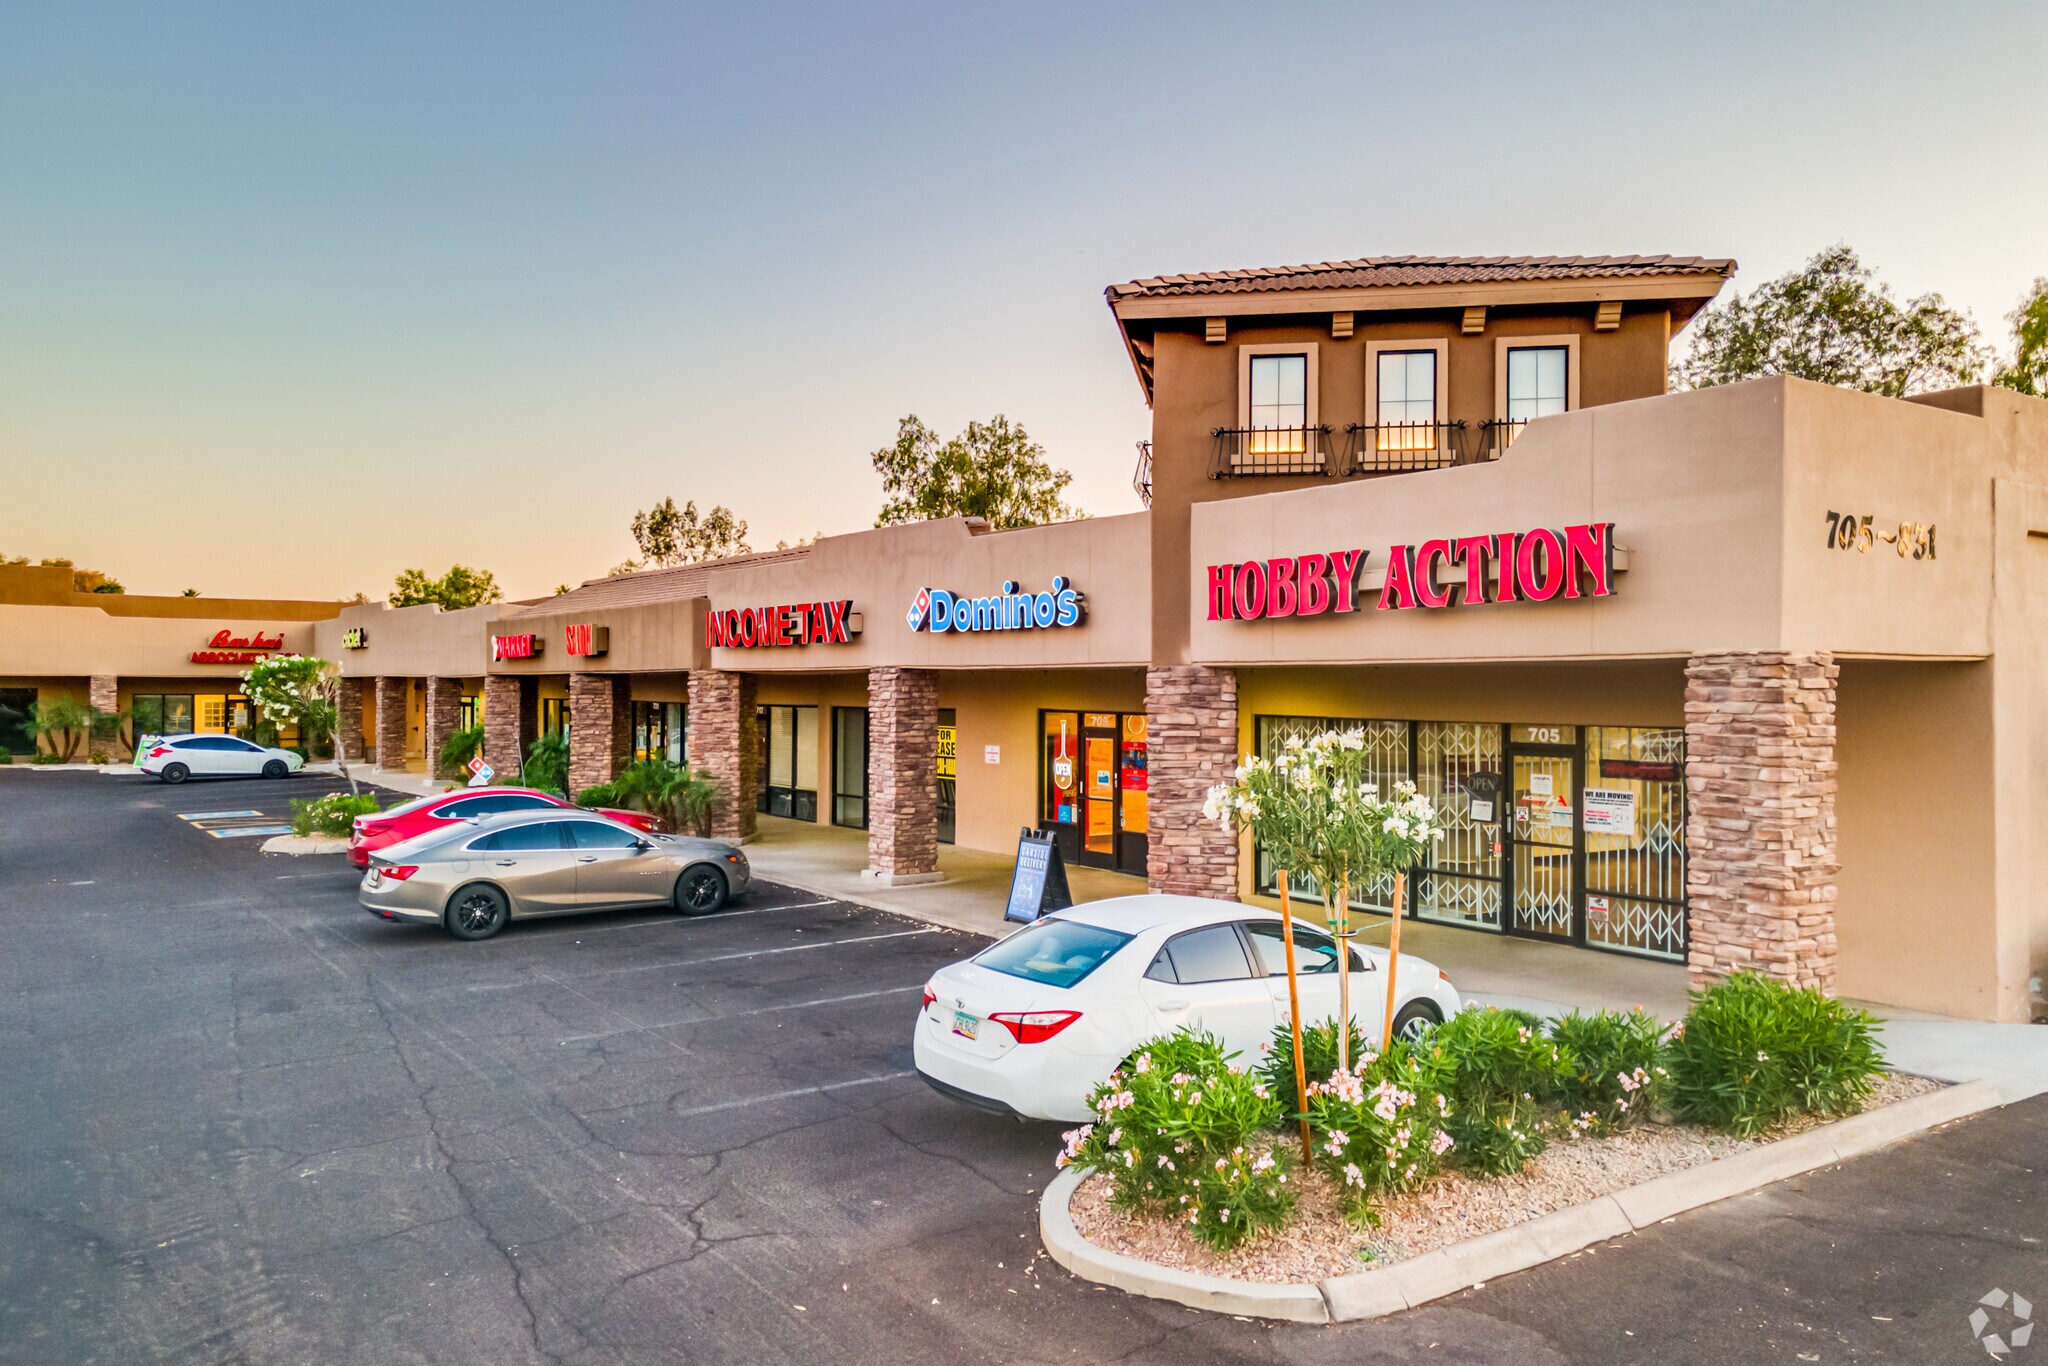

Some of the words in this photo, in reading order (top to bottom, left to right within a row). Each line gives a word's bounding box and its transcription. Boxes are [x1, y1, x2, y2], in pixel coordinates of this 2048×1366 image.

[1206, 549, 1367, 621] HOBBY
[1376, 523, 1613, 610] ACTION
[930, 576, 1081, 632] Domino's
[705, 605, 794, 648] INCOME
[798, 600, 852, 643] TAX
[497, 634, 533, 658] MARKET
[1091, 716, 1109, 727] 709
[1528, 727, 1560, 743] 705
[937, 742, 955, 755] ASE
[1467, 776, 1496, 791] OPEN
[1021, 846, 1048, 860] CARSIDE
[1019, 857, 1047, 871] DELIVERY
